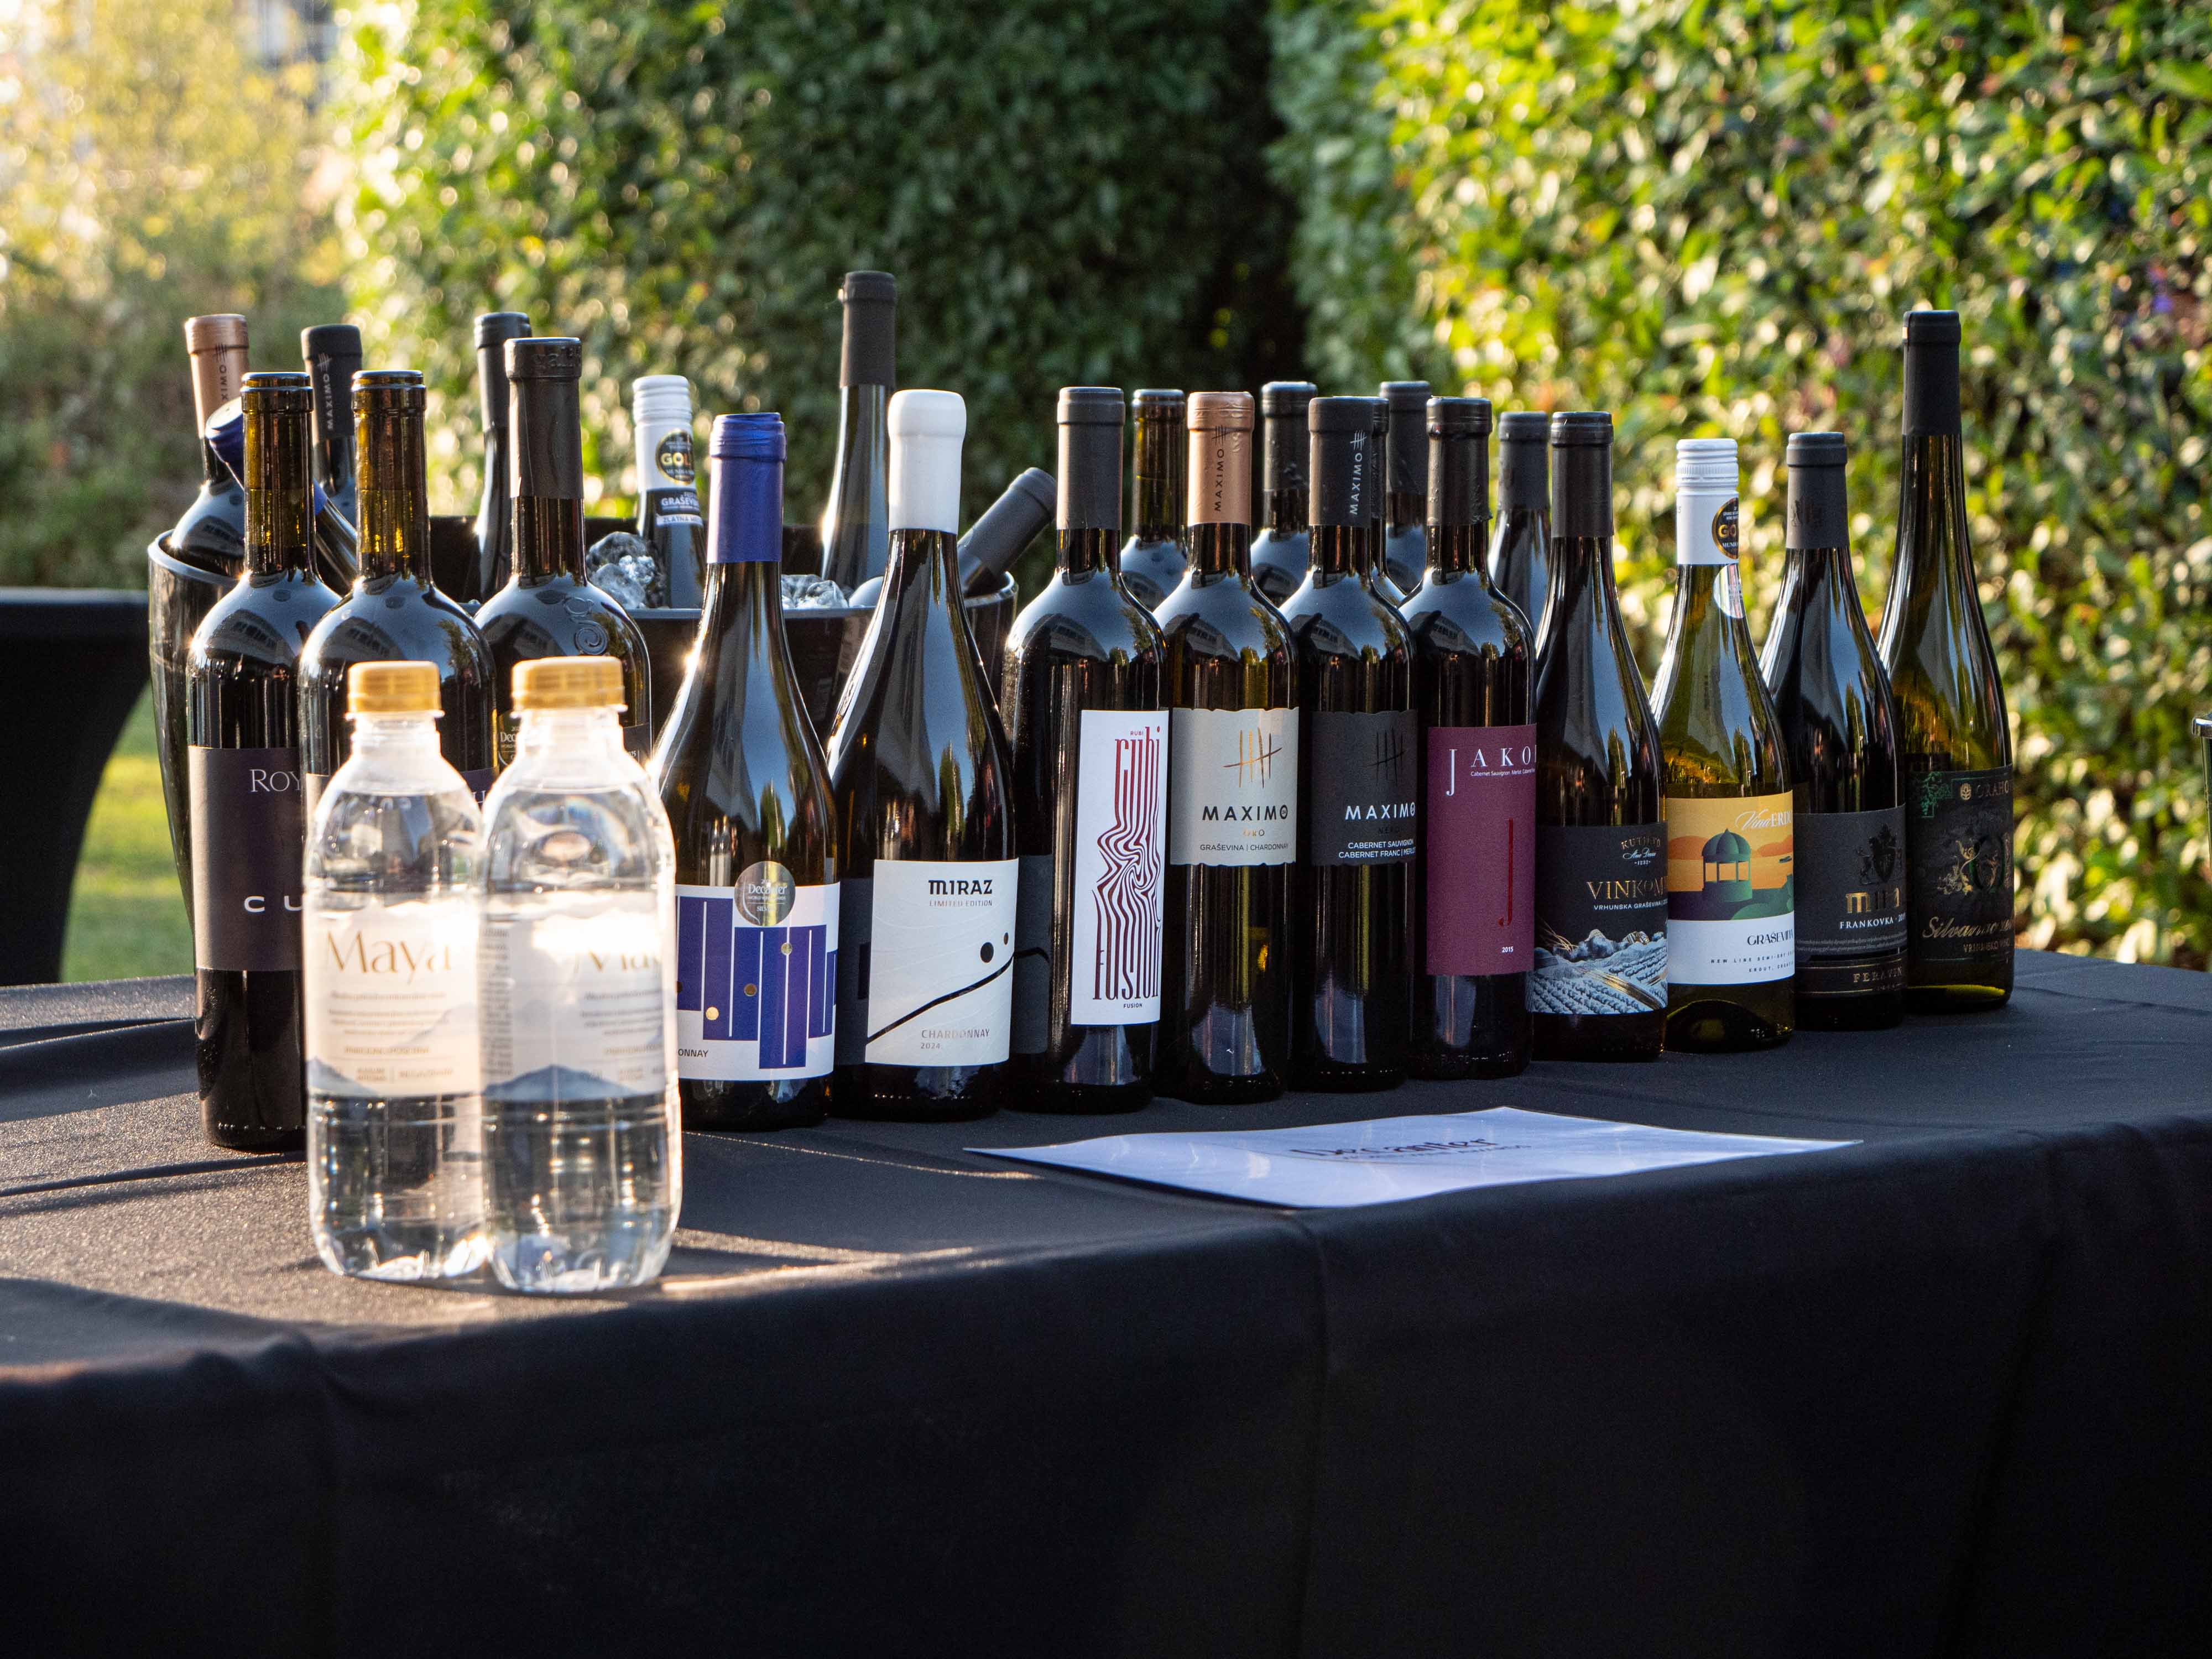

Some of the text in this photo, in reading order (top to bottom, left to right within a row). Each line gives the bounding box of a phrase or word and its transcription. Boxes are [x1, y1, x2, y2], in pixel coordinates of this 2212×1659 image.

[322, 374, 333, 430] MAXIMO
[1214, 448, 1224, 512] MAXIMO
[1349, 452, 1363, 515] MAXIMO
[1446, 744, 1537, 796] JAKO
[1977, 779, 2013, 799] ORAHO
[1202, 804, 1288, 821] MAXIMO
[1345, 801, 1416, 820] MAXIMO
[1199, 842, 1288, 851] GRAŠEVINA CHARDONNAY
[1348, 838, 1415, 849] CABERNET SAUVIGNON
[748, 883, 787, 895] Decaer
[928, 879, 993, 895] MIRAZ
[243, 895, 303, 913] CU
[1594, 902, 1632, 911] VRHUNSKA
[1839, 916, 1894, 930] FRANKOVKA
[921, 1028, 990, 1039] CHARDONNAY
[677, 1048, 708, 1058] ONNAY
